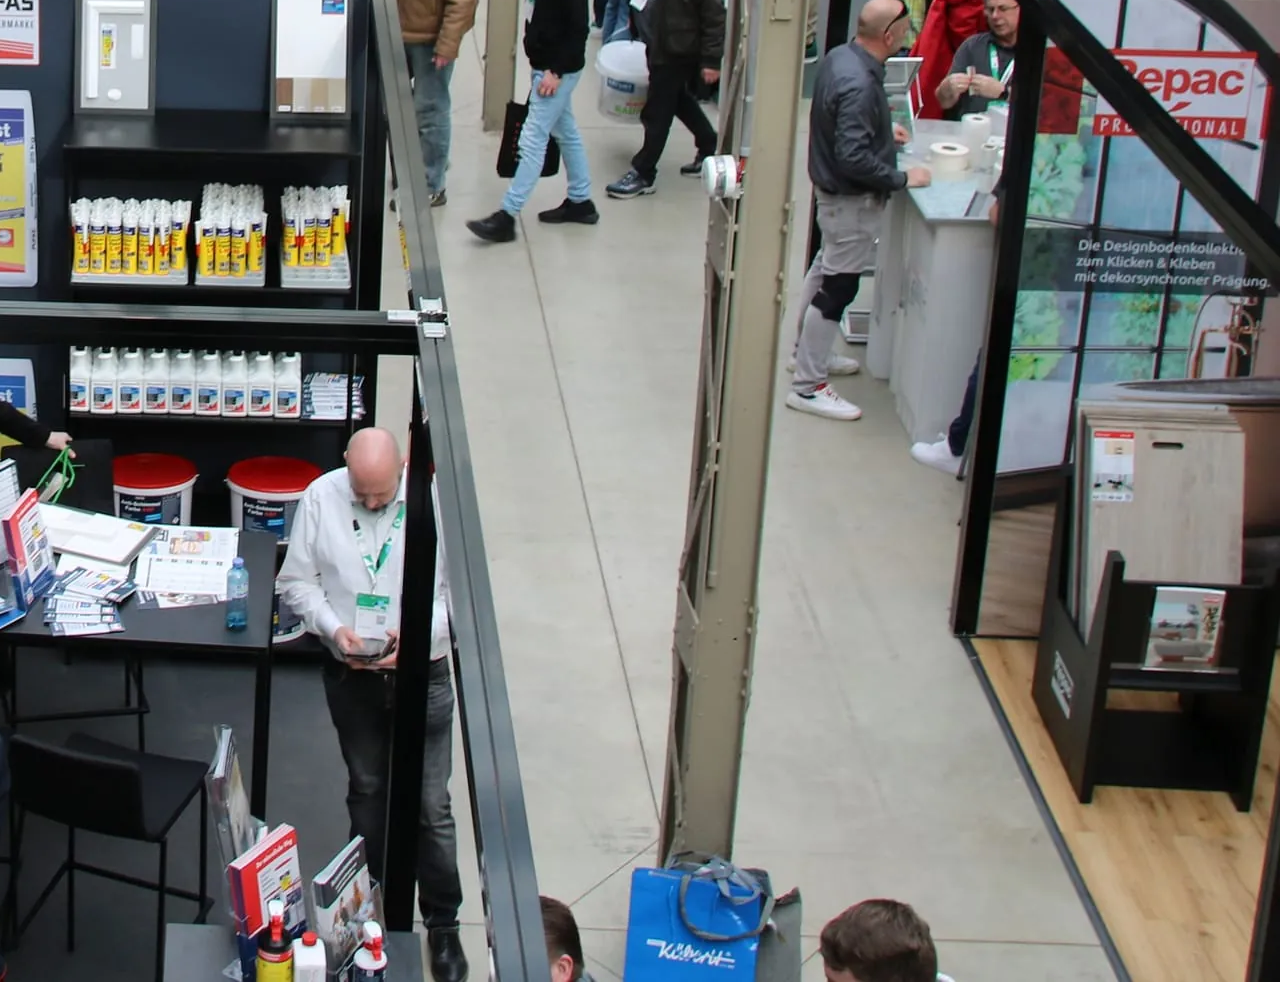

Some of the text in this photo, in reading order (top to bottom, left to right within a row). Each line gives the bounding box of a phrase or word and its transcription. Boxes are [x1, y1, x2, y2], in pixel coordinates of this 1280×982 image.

[1099, 119, 1239, 136] PRIONAL
[1078, 240, 1246, 256] Die Designbodenkollekti
[1076, 255, 1216, 271] zum Klicken & Kleben
[1074, 271, 1097, 283] mit
[1099, 271, 1209, 288] dekorsynchroner
